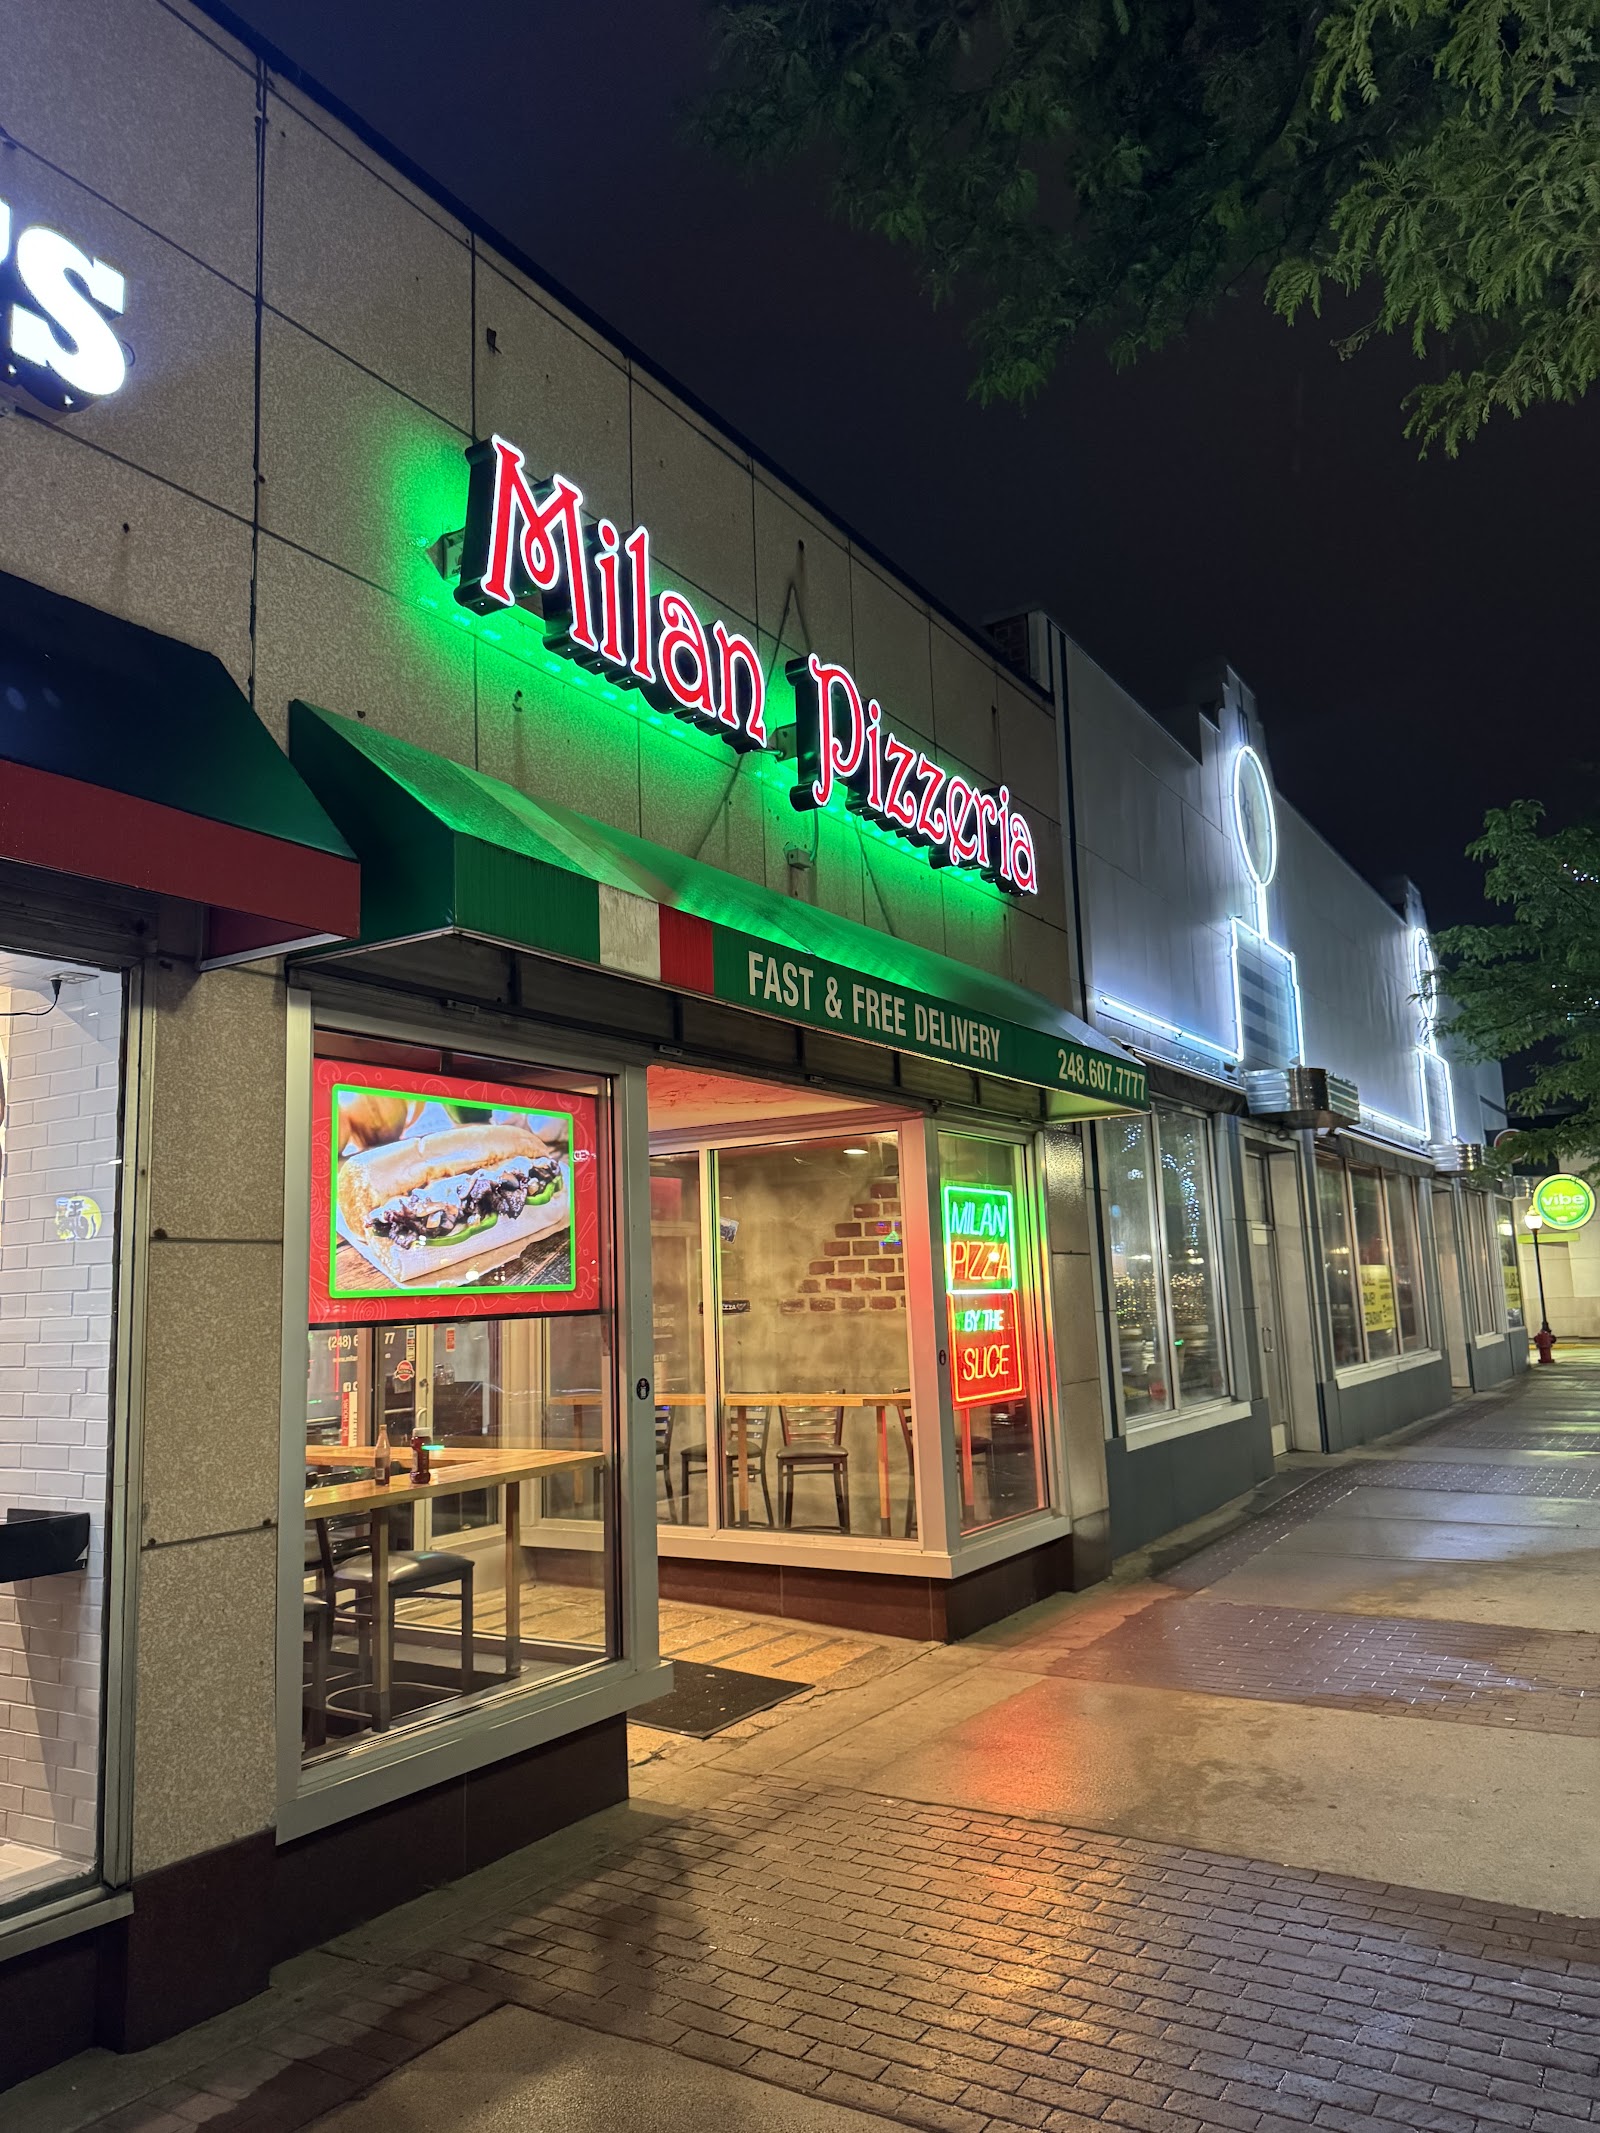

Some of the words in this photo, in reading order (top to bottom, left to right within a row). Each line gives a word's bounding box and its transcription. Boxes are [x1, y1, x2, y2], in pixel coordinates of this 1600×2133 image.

[0, 198, 126, 395] S
[482, 433, 768, 748] Milan
[808, 652, 1039, 896] Pizzeria
[747, 950, 814, 1012] FAST
[824, 975, 843, 1020] &
[852, 982, 907, 1038] FREE
[915, 1003, 1000, 1063] DELIVERY
[1058, 1048, 1146, 1101] 248.607.7777
[950, 1201, 1007, 1238] MILAN
[1541, 1192, 1586, 1206] vibe
[951, 1240, 1012, 1281] PIZZA
[963, 1309, 981, 1332] BY
[983, 1308, 1005, 1331] THE
[963, 1344, 1011, 1382] SLICE
